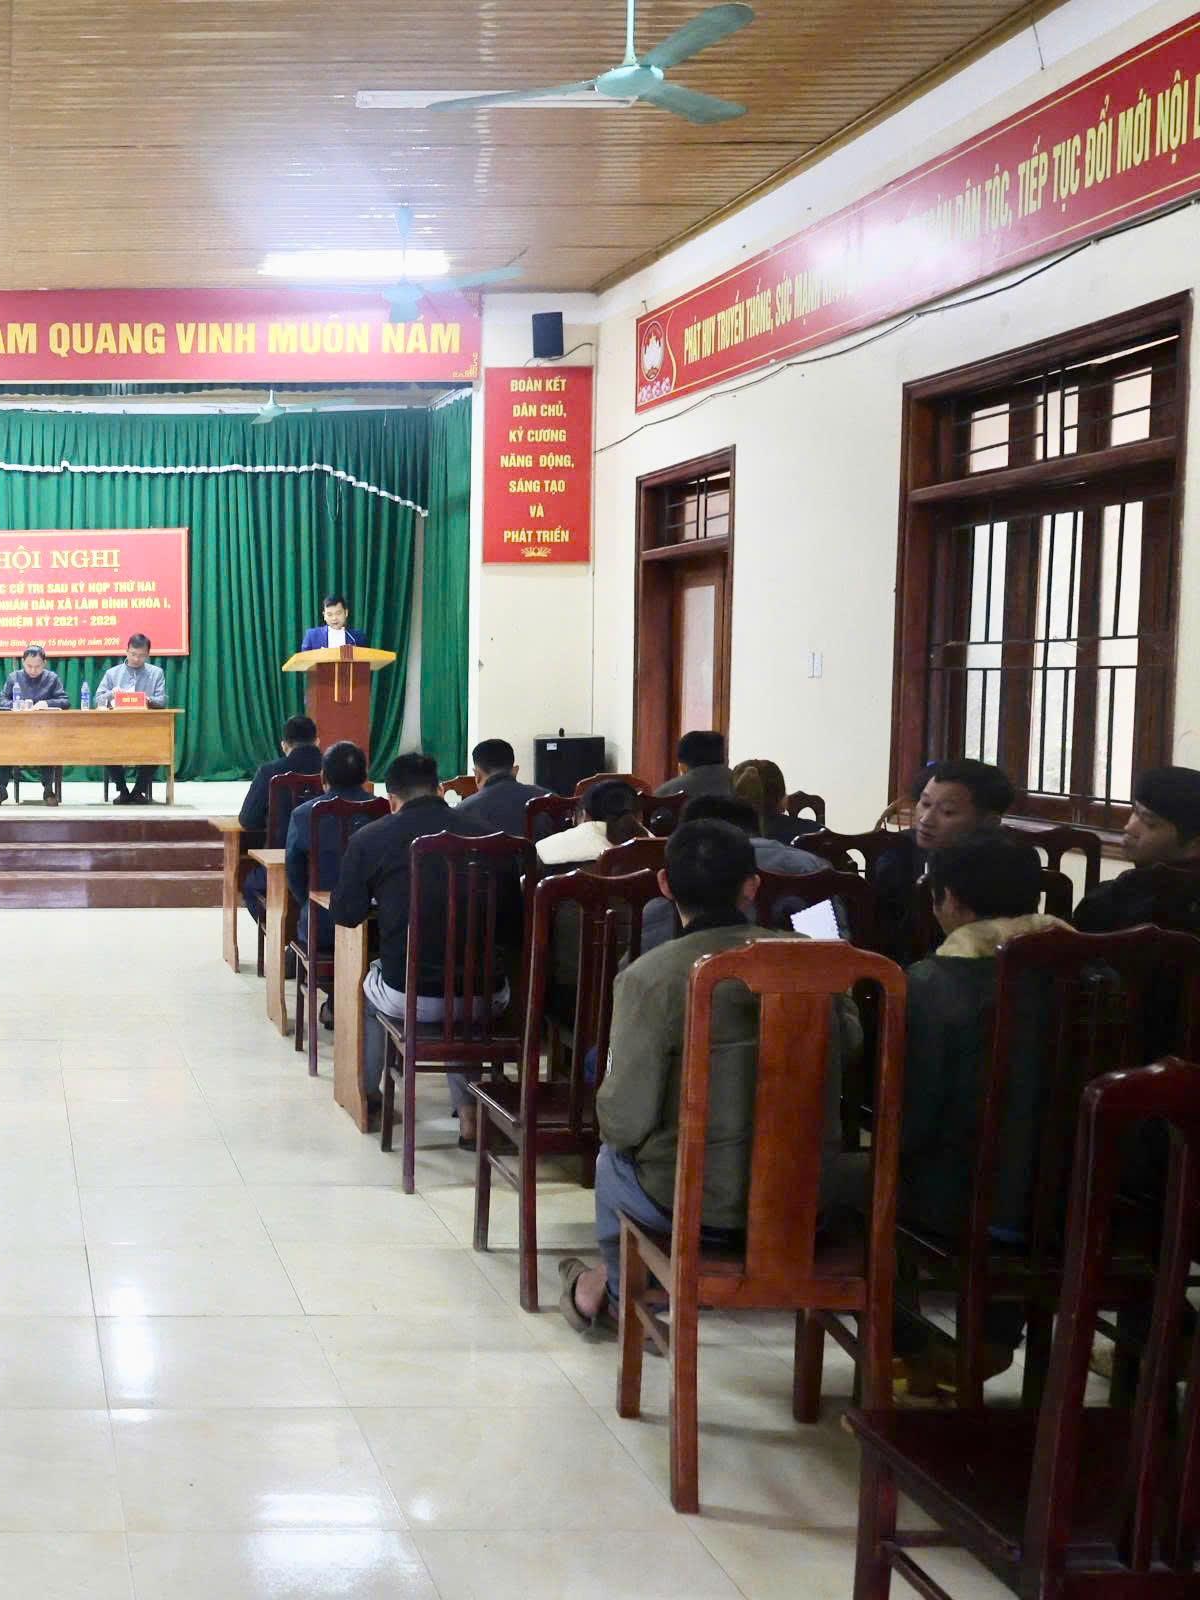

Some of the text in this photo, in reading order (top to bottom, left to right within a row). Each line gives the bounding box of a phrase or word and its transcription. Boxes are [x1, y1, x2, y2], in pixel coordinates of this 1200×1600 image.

[683, 315, 701, 366] PHÁT
[701, 315, 717, 359] HUY
[746, 277, 774, 339] THỐNG,
[775, 270, 793, 327] SỨC
[985, 163, 1012, 243] TỘC,
[1018, 135, 1048, 218] TIẾP
[1052, 134, 1081, 212] TỤC
[1084, 94, 1114, 188] ĐỔI
[1116, 88, 1151, 174] MỚI
[1155, 69, 1189, 164] NỘI
[49, 322, 166, 358] QUANG
[175, 322, 256, 354] VINH
[268, 313, 369, 354] MUÔN
[510, 374, 566, 392] ĐOÀN KẾT
[540, 400, 567, 418] CHỦ,
[527, 428, 567, 442] CƯƠNG
[500, 452, 575, 470] NĂNG ĐỘNG,
[509, 477, 566, 495] SÁNG TẠO
[529, 502, 544, 518] VÀ
[503, 524, 569, 543] PHÁT TRIỂN
[50, 549, 121, 573] NGHỊ
[26, 583, 44, 594] TRI
[47, 583, 69, 594] SAU
[88, 582, 111, 594] HỌP
[137, 581, 156, 592] HAI
[31, 598, 55, 611] DÂN
[57, 597, 72, 610] XÃ
[74, 597, 99, 609] LÂM
[101, 596, 129, 609] BÌNH
[53, 616, 79, 627] 2021
